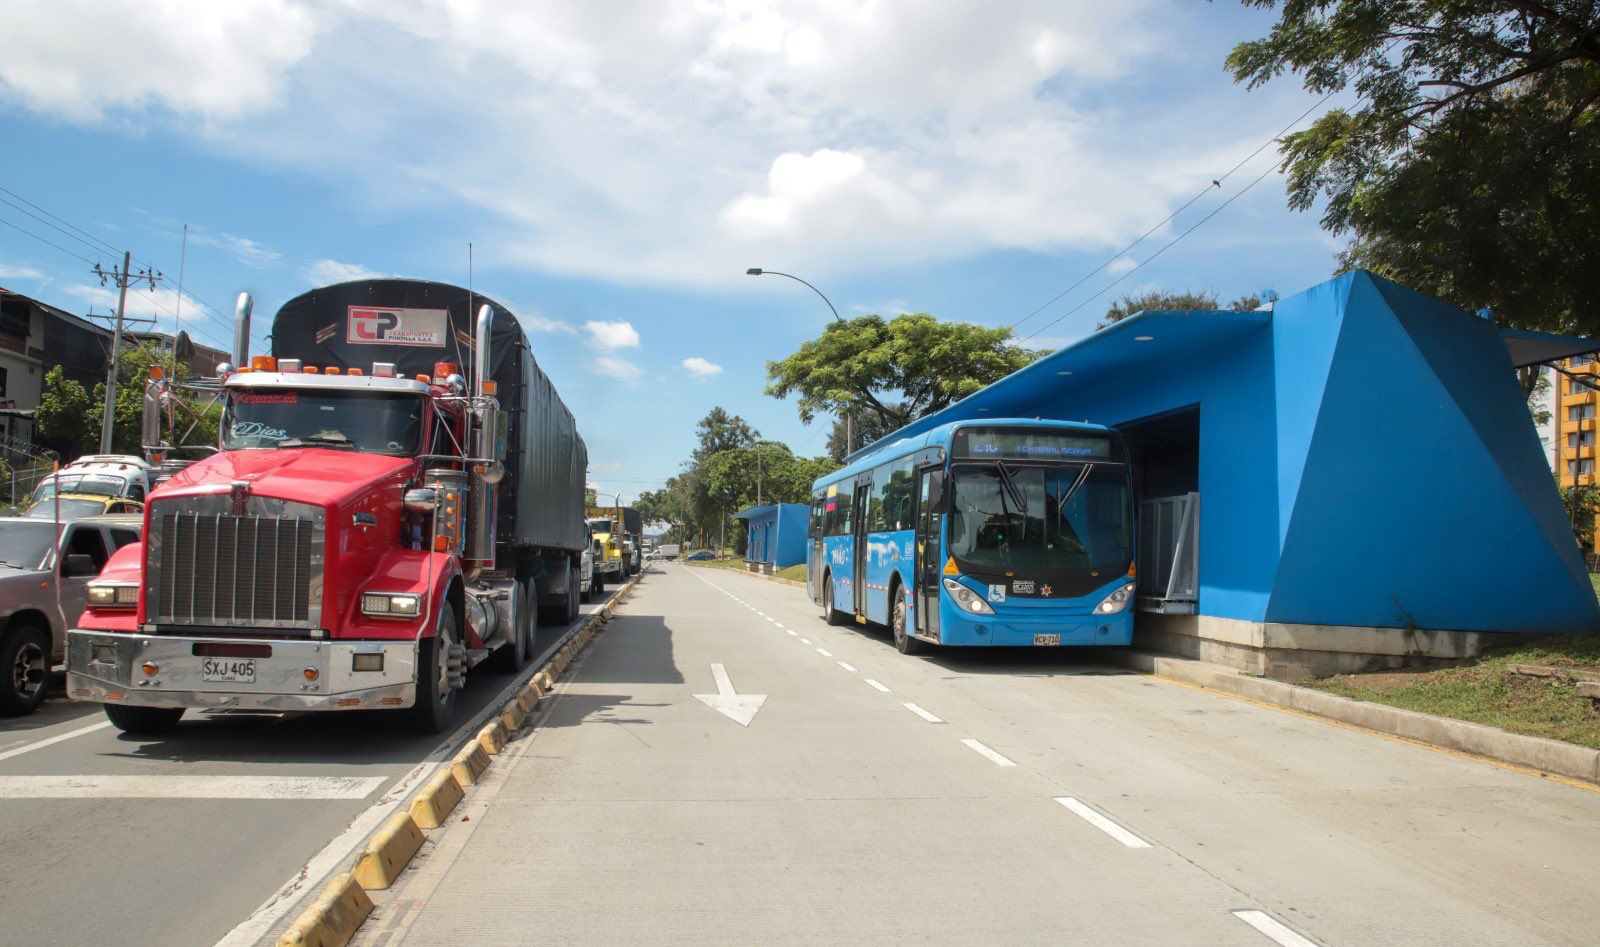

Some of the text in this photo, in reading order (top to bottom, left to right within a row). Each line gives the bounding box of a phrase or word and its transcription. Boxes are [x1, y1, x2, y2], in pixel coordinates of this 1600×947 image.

[232, 421, 290, 440] Dios
[204, 661, 254, 677] SXJ 405
